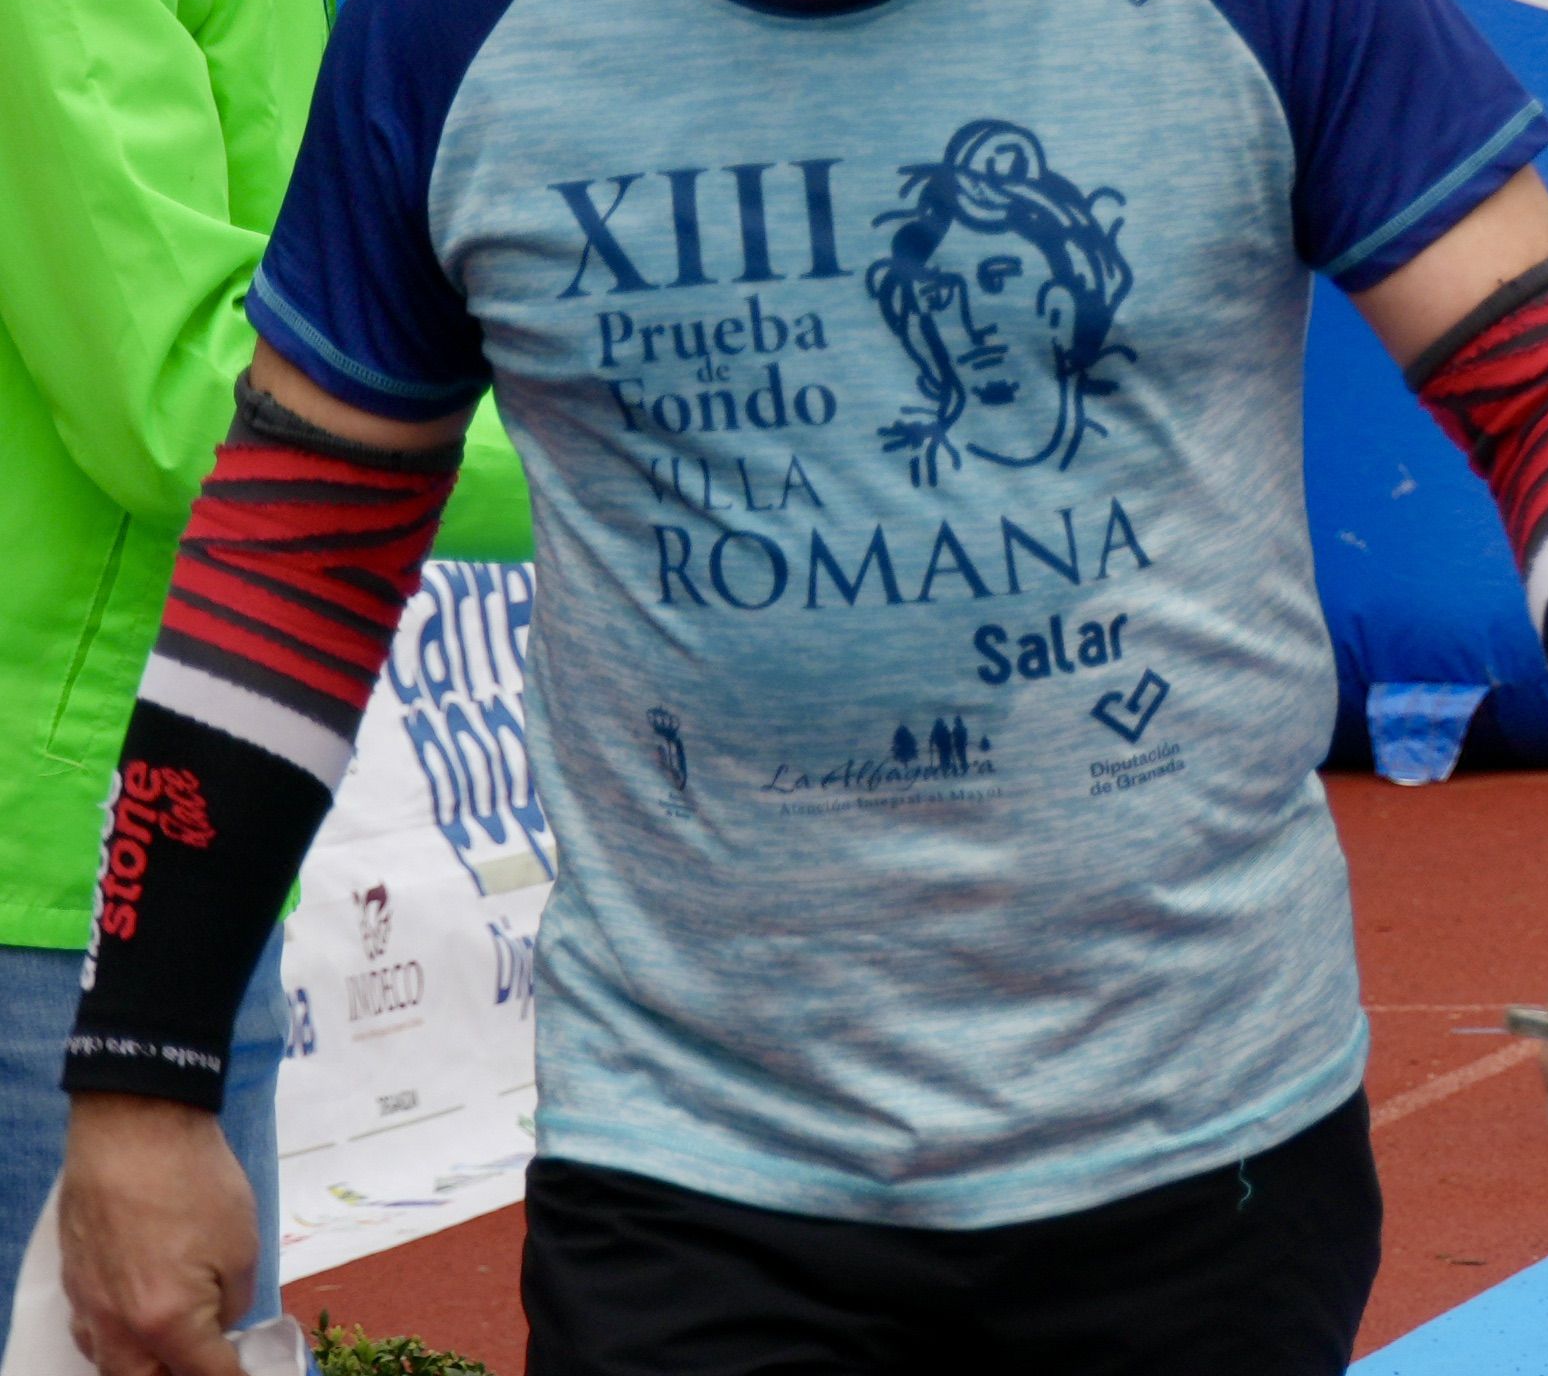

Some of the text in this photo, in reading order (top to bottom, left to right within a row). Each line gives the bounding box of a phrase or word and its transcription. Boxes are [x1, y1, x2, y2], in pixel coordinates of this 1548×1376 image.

[547, 157, 854, 300] XIII
[594, 293, 831, 368] Prueba
[602, 362, 838, 434] Fondo
[695, 356, 732, 384] de
[650, 454, 826, 513] VILLA
[654, 496, 1156, 611] ROMANA
[973, 612, 1129, 686] Salar
[1088, 741, 1182, 780] Diputación
[1089, 757, 1186, 798] de Granada
[101, 759, 163, 942] stone
